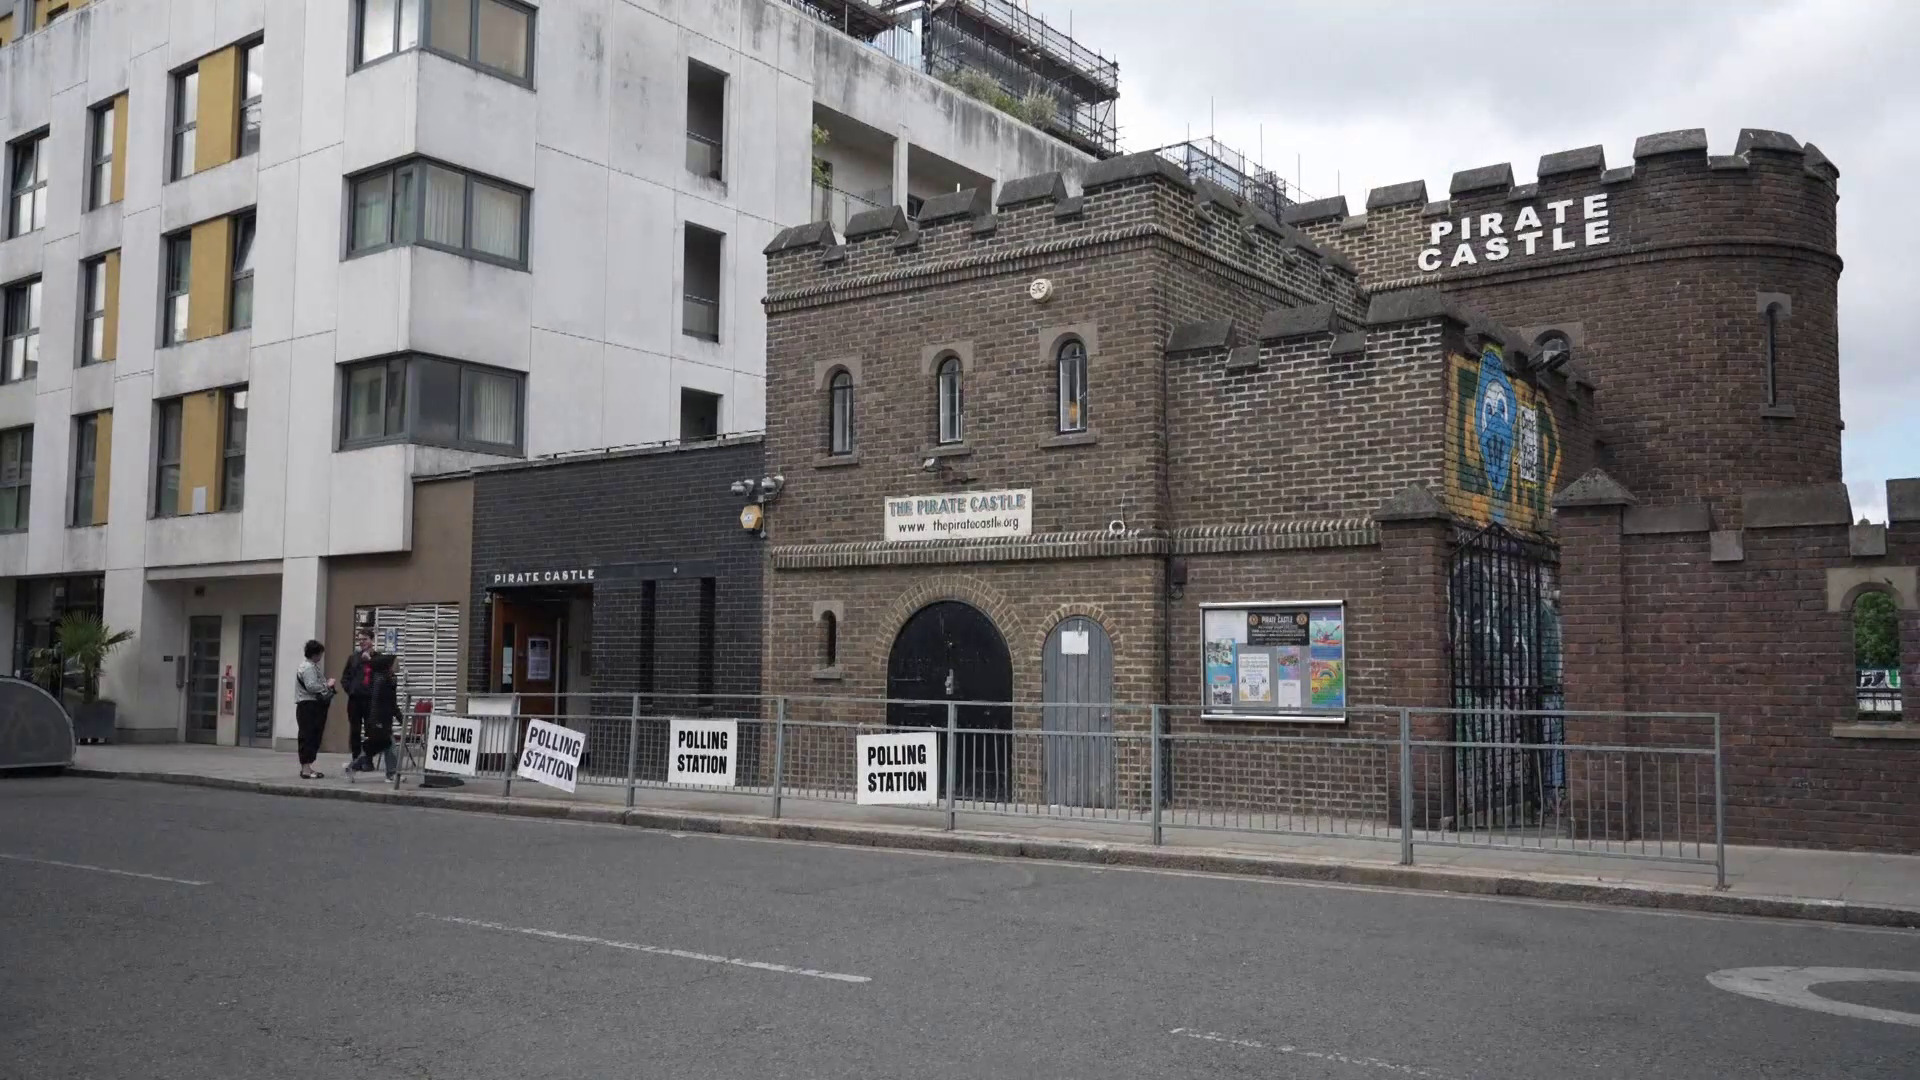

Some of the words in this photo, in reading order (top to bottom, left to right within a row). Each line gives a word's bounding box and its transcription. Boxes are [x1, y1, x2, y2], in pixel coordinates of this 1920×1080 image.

[1430, 193, 1608, 245] PIRATE
[1418, 220, 1610, 271] CASTLE
[888, 501, 913, 517] THE
[917, 498, 967, 515] PIRATE
[970, 493, 1026, 511] CASTLE
[494, 572, 539, 583] PIRATE
[544, 569, 595, 581] CASTLE
[435, 725, 473, 744] POLLING
[528, 726, 581, 758] POLLING
[678, 730, 728, 750] POLLING
[432, 745, 471, 765] STATION
[677, 754, 727, 774] STATION
[867, 744, 926, 766] POLLING
[523, 750, 574, 782] STATION
[867, 771, 927, 792] STATION
